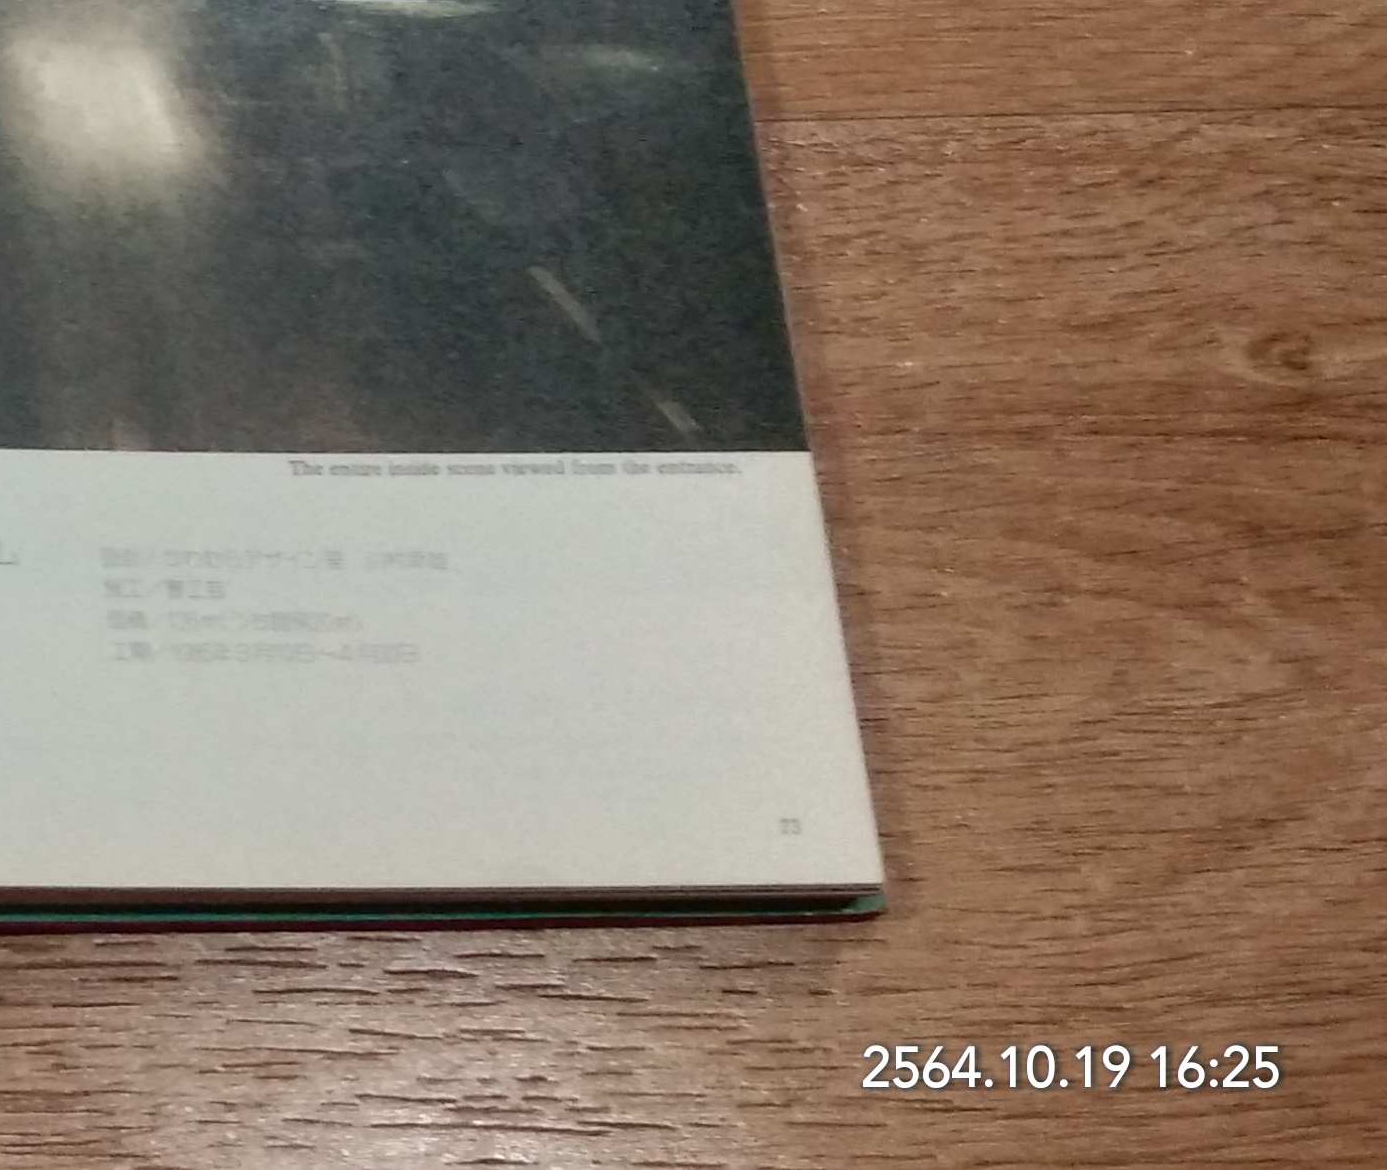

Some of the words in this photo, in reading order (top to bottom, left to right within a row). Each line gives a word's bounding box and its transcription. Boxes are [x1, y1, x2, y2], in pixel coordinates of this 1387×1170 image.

[288, 460, 323, 476] The
[572, 459, 616, 477] from
[622, 459, 651, 477] the
